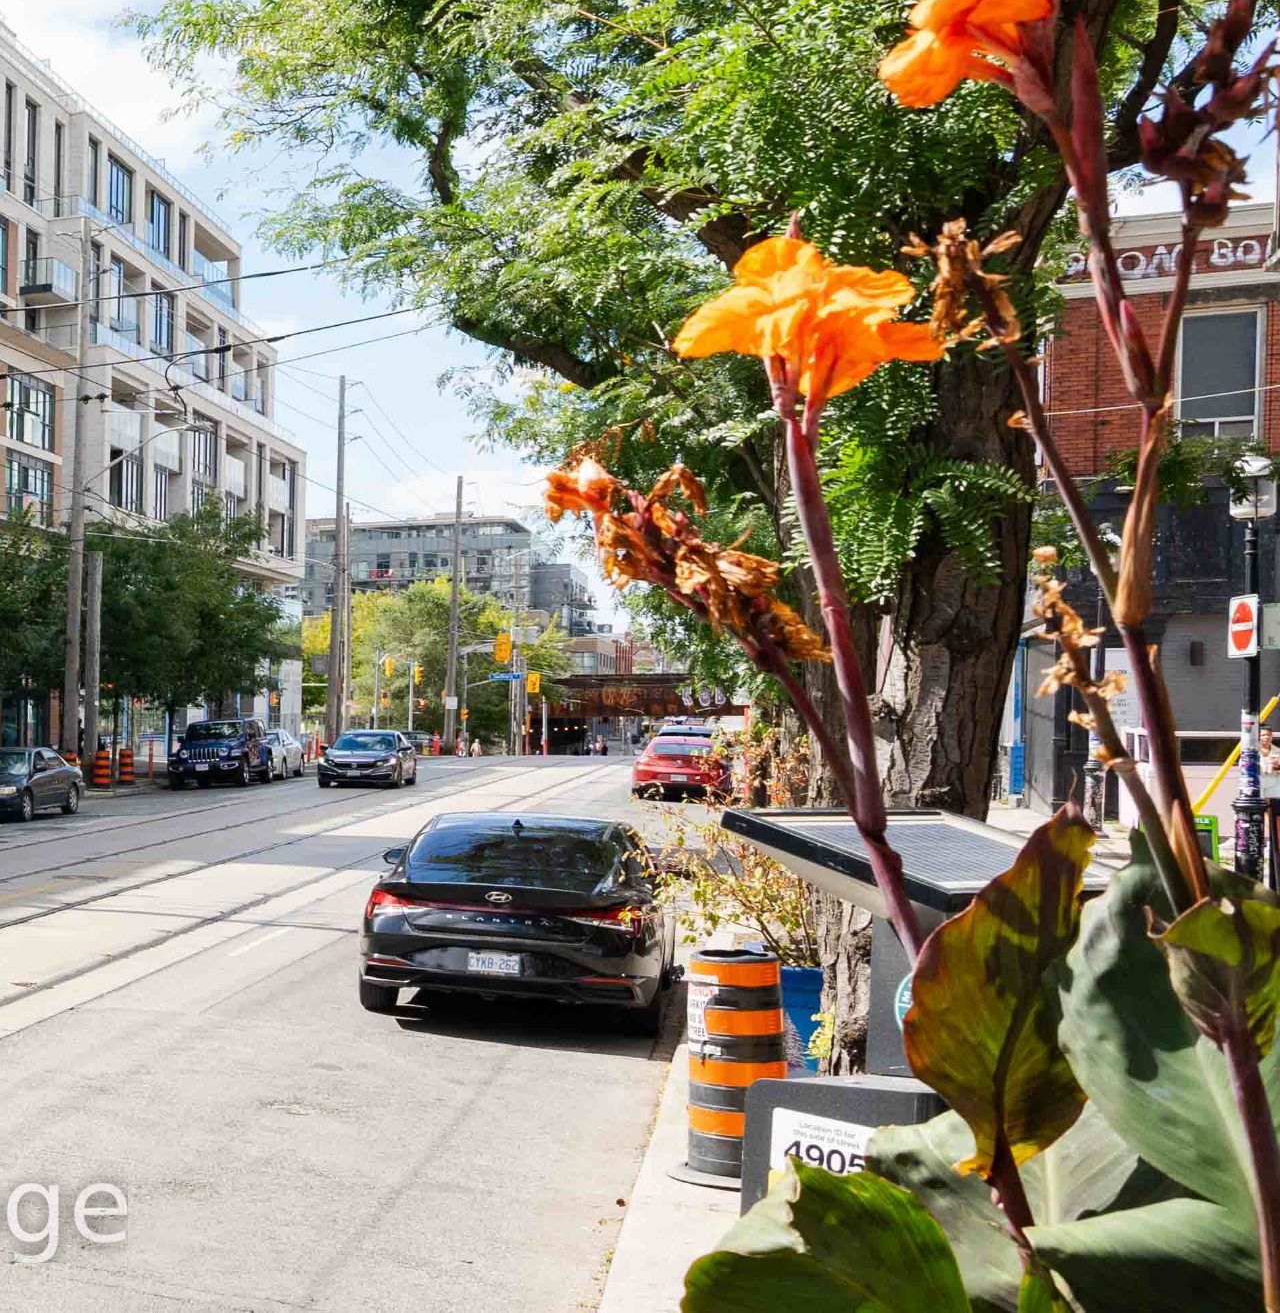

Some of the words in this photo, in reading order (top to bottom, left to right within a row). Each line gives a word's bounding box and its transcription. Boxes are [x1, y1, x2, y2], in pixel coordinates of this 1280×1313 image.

[445, 913, 552, 926] ELANTRA
[799, 1121, 832, 1134] Location
[844, 1131, 856, 1139] for
[793, 1129, 807, 1139] this
[810, 1132, 825, 1142] side
[836, 1138, 860, 1150] street
